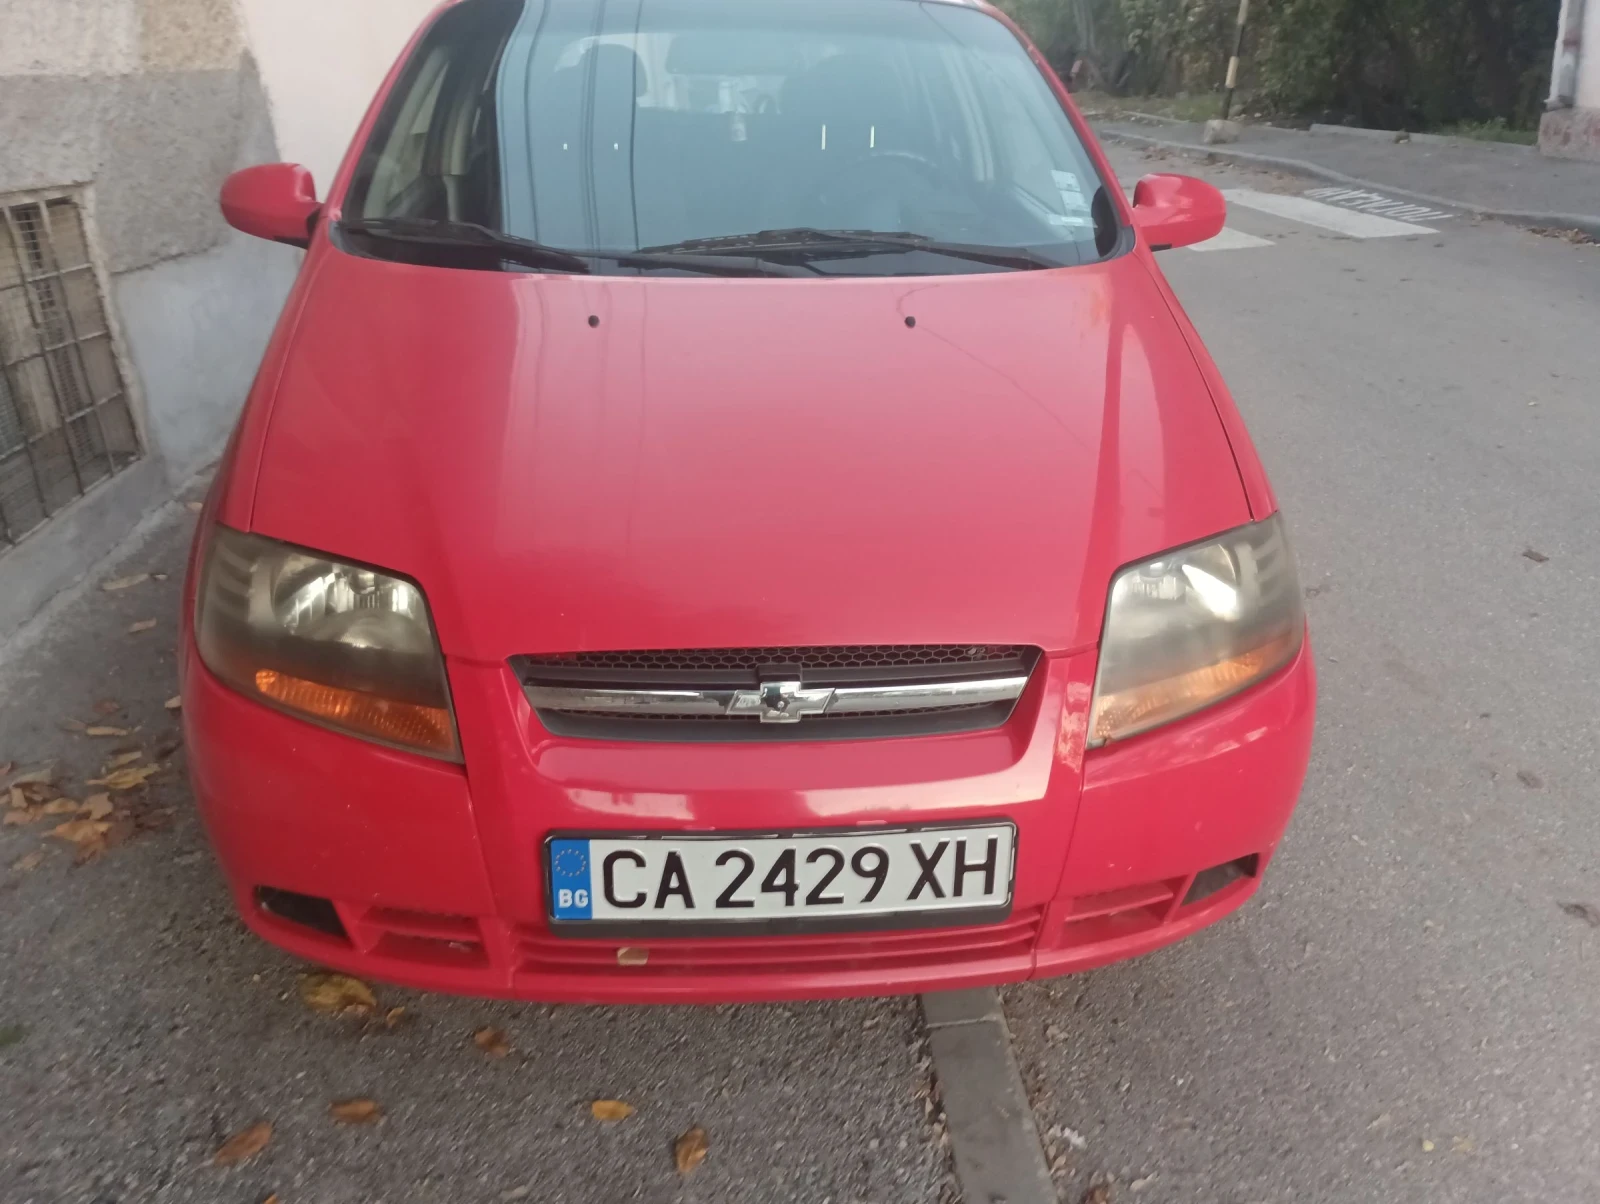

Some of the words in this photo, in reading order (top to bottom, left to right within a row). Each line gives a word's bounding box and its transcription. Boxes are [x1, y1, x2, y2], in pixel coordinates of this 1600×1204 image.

[603, 849, 696, 910] CA
[714, 846, 891, 909] 2429
[906, 834, 999, 900] XH
[558, 888, 589, 909] BG
